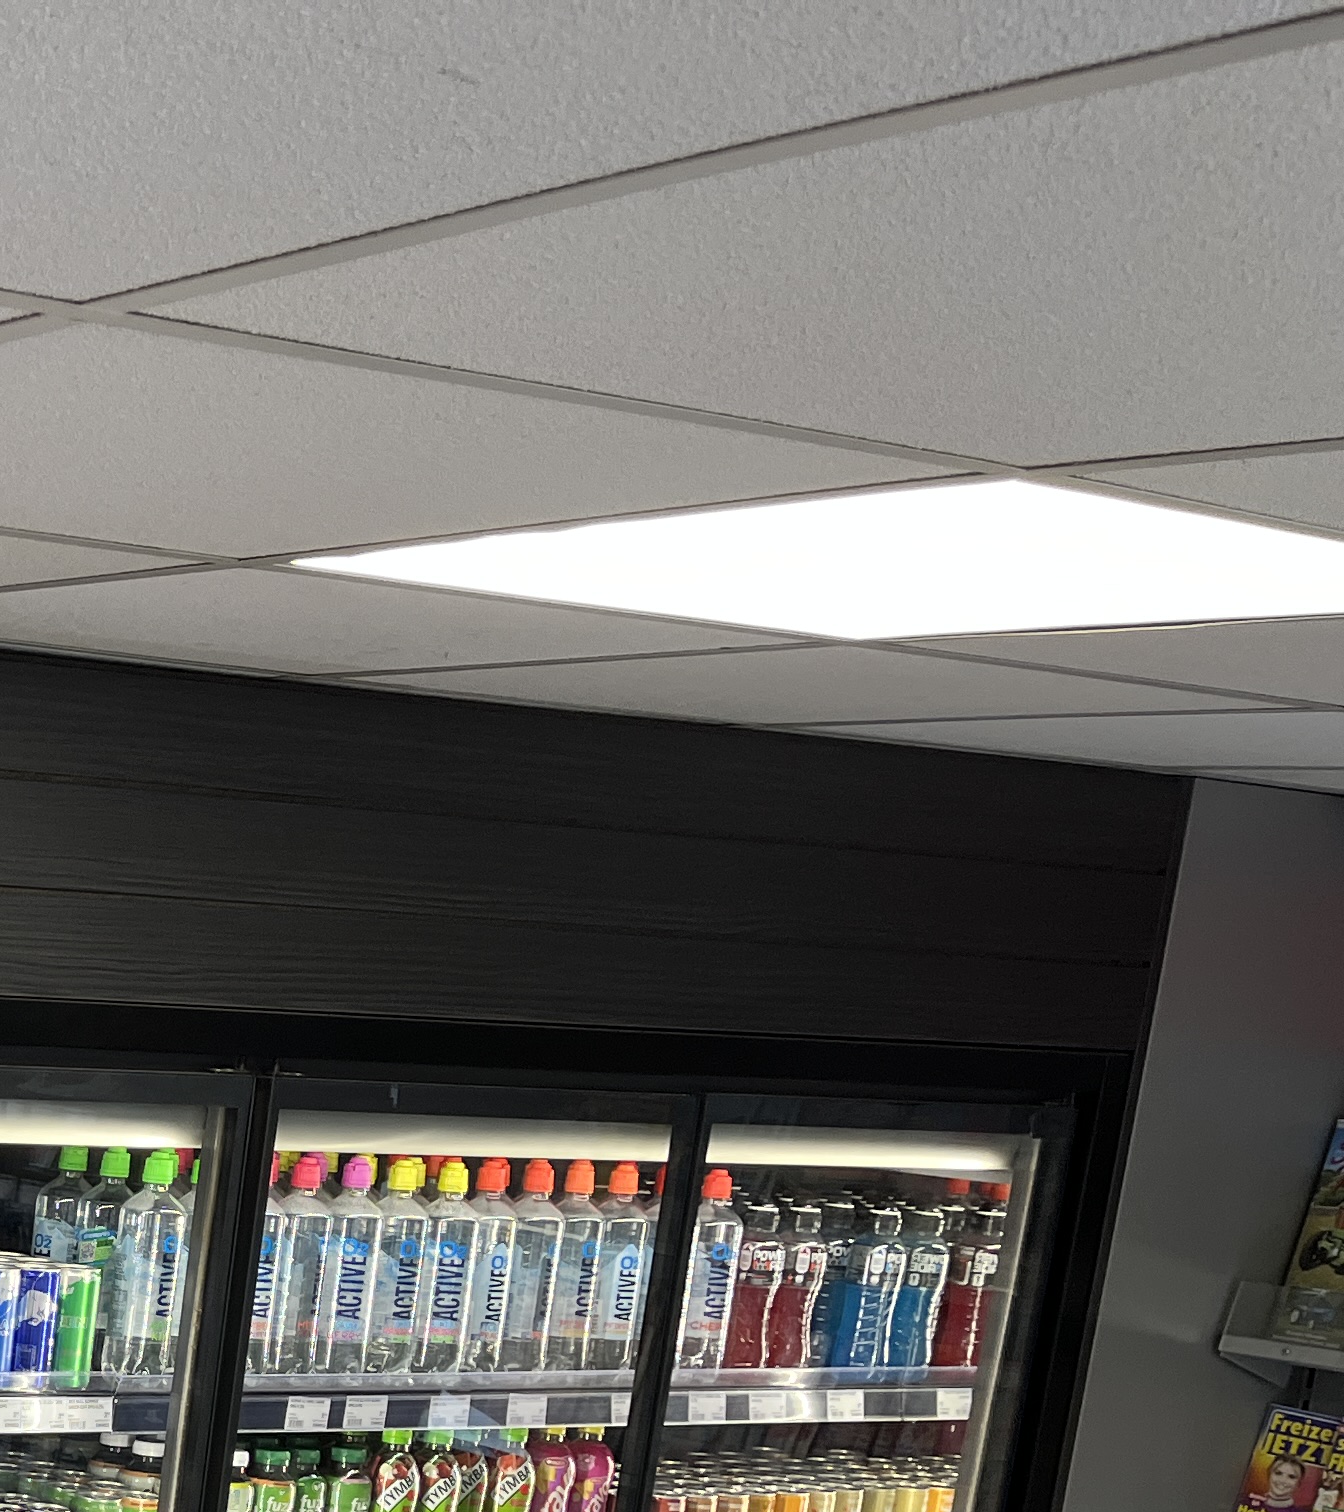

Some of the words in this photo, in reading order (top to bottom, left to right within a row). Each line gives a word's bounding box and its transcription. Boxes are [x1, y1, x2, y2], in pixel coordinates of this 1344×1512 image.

[336, 1256, 367, 1318] ACTIVE
[433, 1256, 466, 1321] ACTIVE
[614, 1271, 641, 1321] ACTIVE
